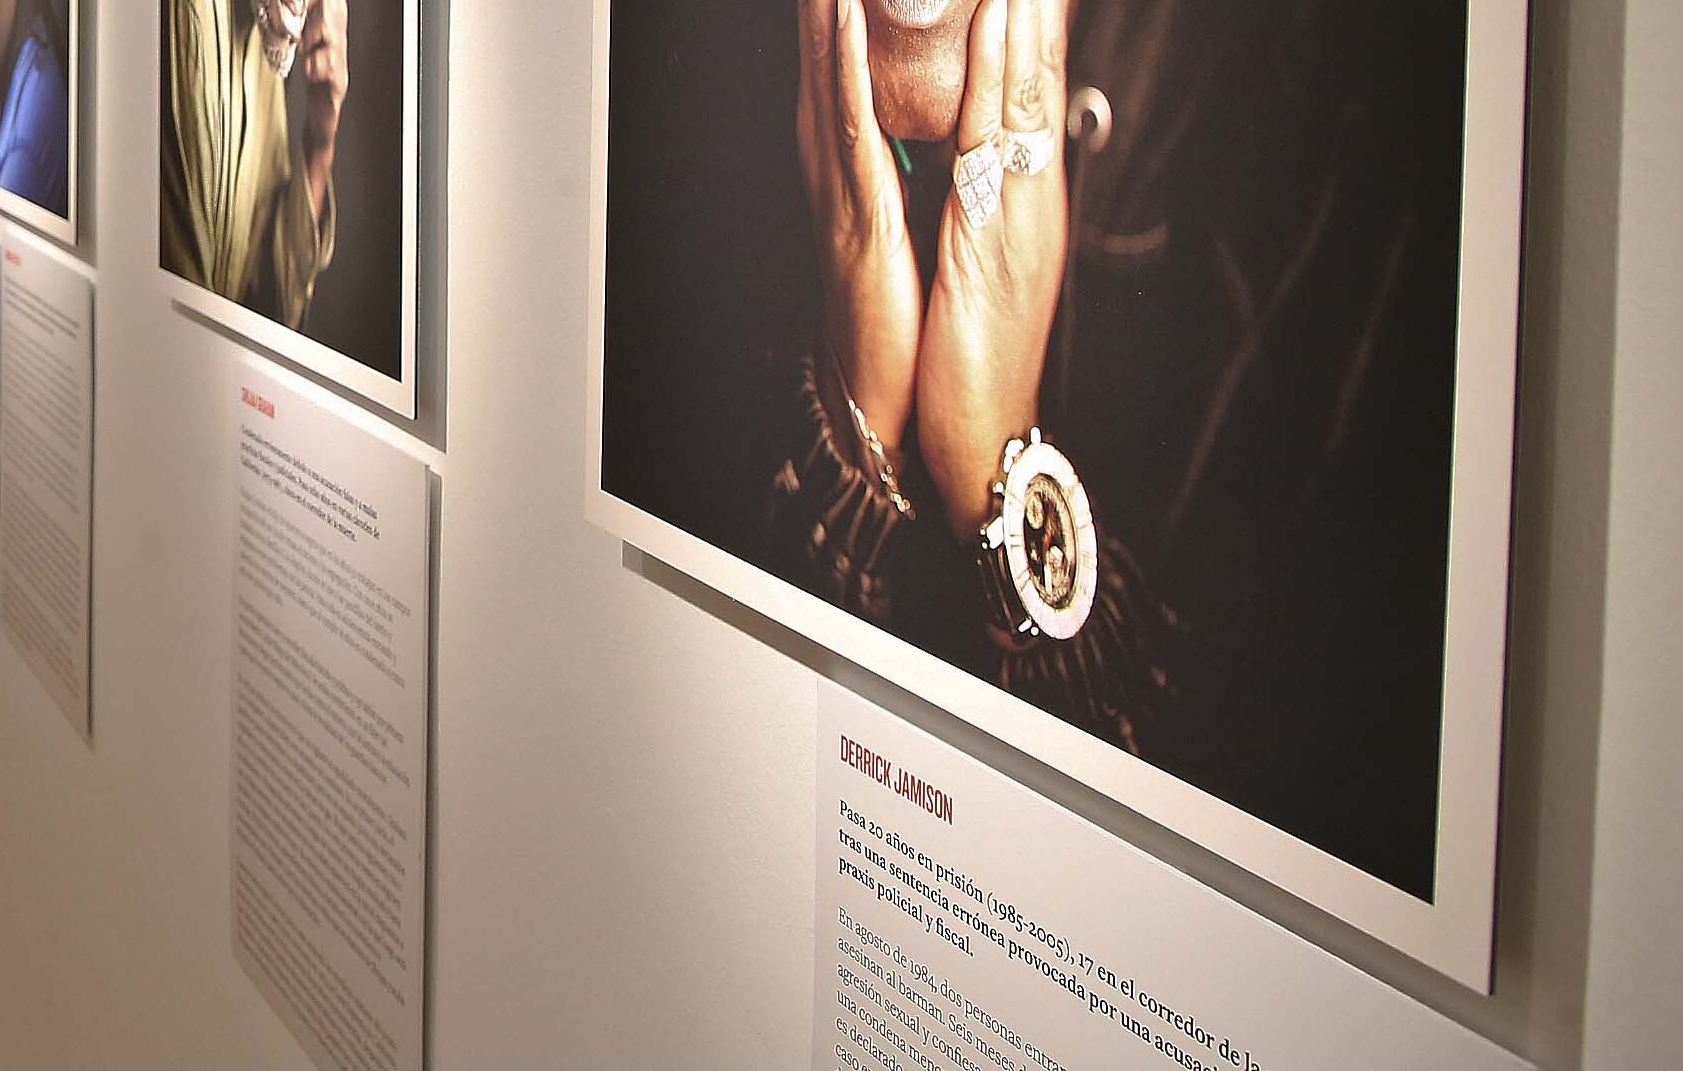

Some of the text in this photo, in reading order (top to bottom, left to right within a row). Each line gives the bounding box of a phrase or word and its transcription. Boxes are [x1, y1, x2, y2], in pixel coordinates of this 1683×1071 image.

[840, 735, 953, 825] DERRICK JAMISON
[839, 857, 974, 957] praxis policial y fiscal.
[839, 800, 866, 829] Pasa
[869, 821, 883, 839] 20
[886, 832, 915, 860] años
[918, 852, 933, 872] en
[936, 863, 984, 904] prisión
[987, 892, 1074, 965] (1985-2005),
[1078, 953, 1094, 976] 17
[1098, 966, 1117, 988] en
[1120, 979, 1134, 1000] el
[1139, 992, 1214, 1049] corredor
[1219, 1038, 1240, 1066] de
[839, 828, 1219, 1071] tras una sentencia errónea provocada por una acusa
[837, 938, 1014, 1071] asesinan al barman. Seis meses
[837, 964, 882, 1007] agresión
[885, 998, 920, 1035] sexual
[922, 1026, 930, 1045] y
[837, 990, 857, 1015] una
[859, 1007, 907, 1053] condena
[838, 906, 853, 930] En
[855, 922, 891, 956] agosto
[893, 945, 907, 968] de
[910, 960, 937, 993] 1984,
[941, 980, 962, 1008] dos
[964, 999, 1021, 1049] personas
[835, 1044, 860, 1071] caso
[836, 1018, 848, 1035] es
